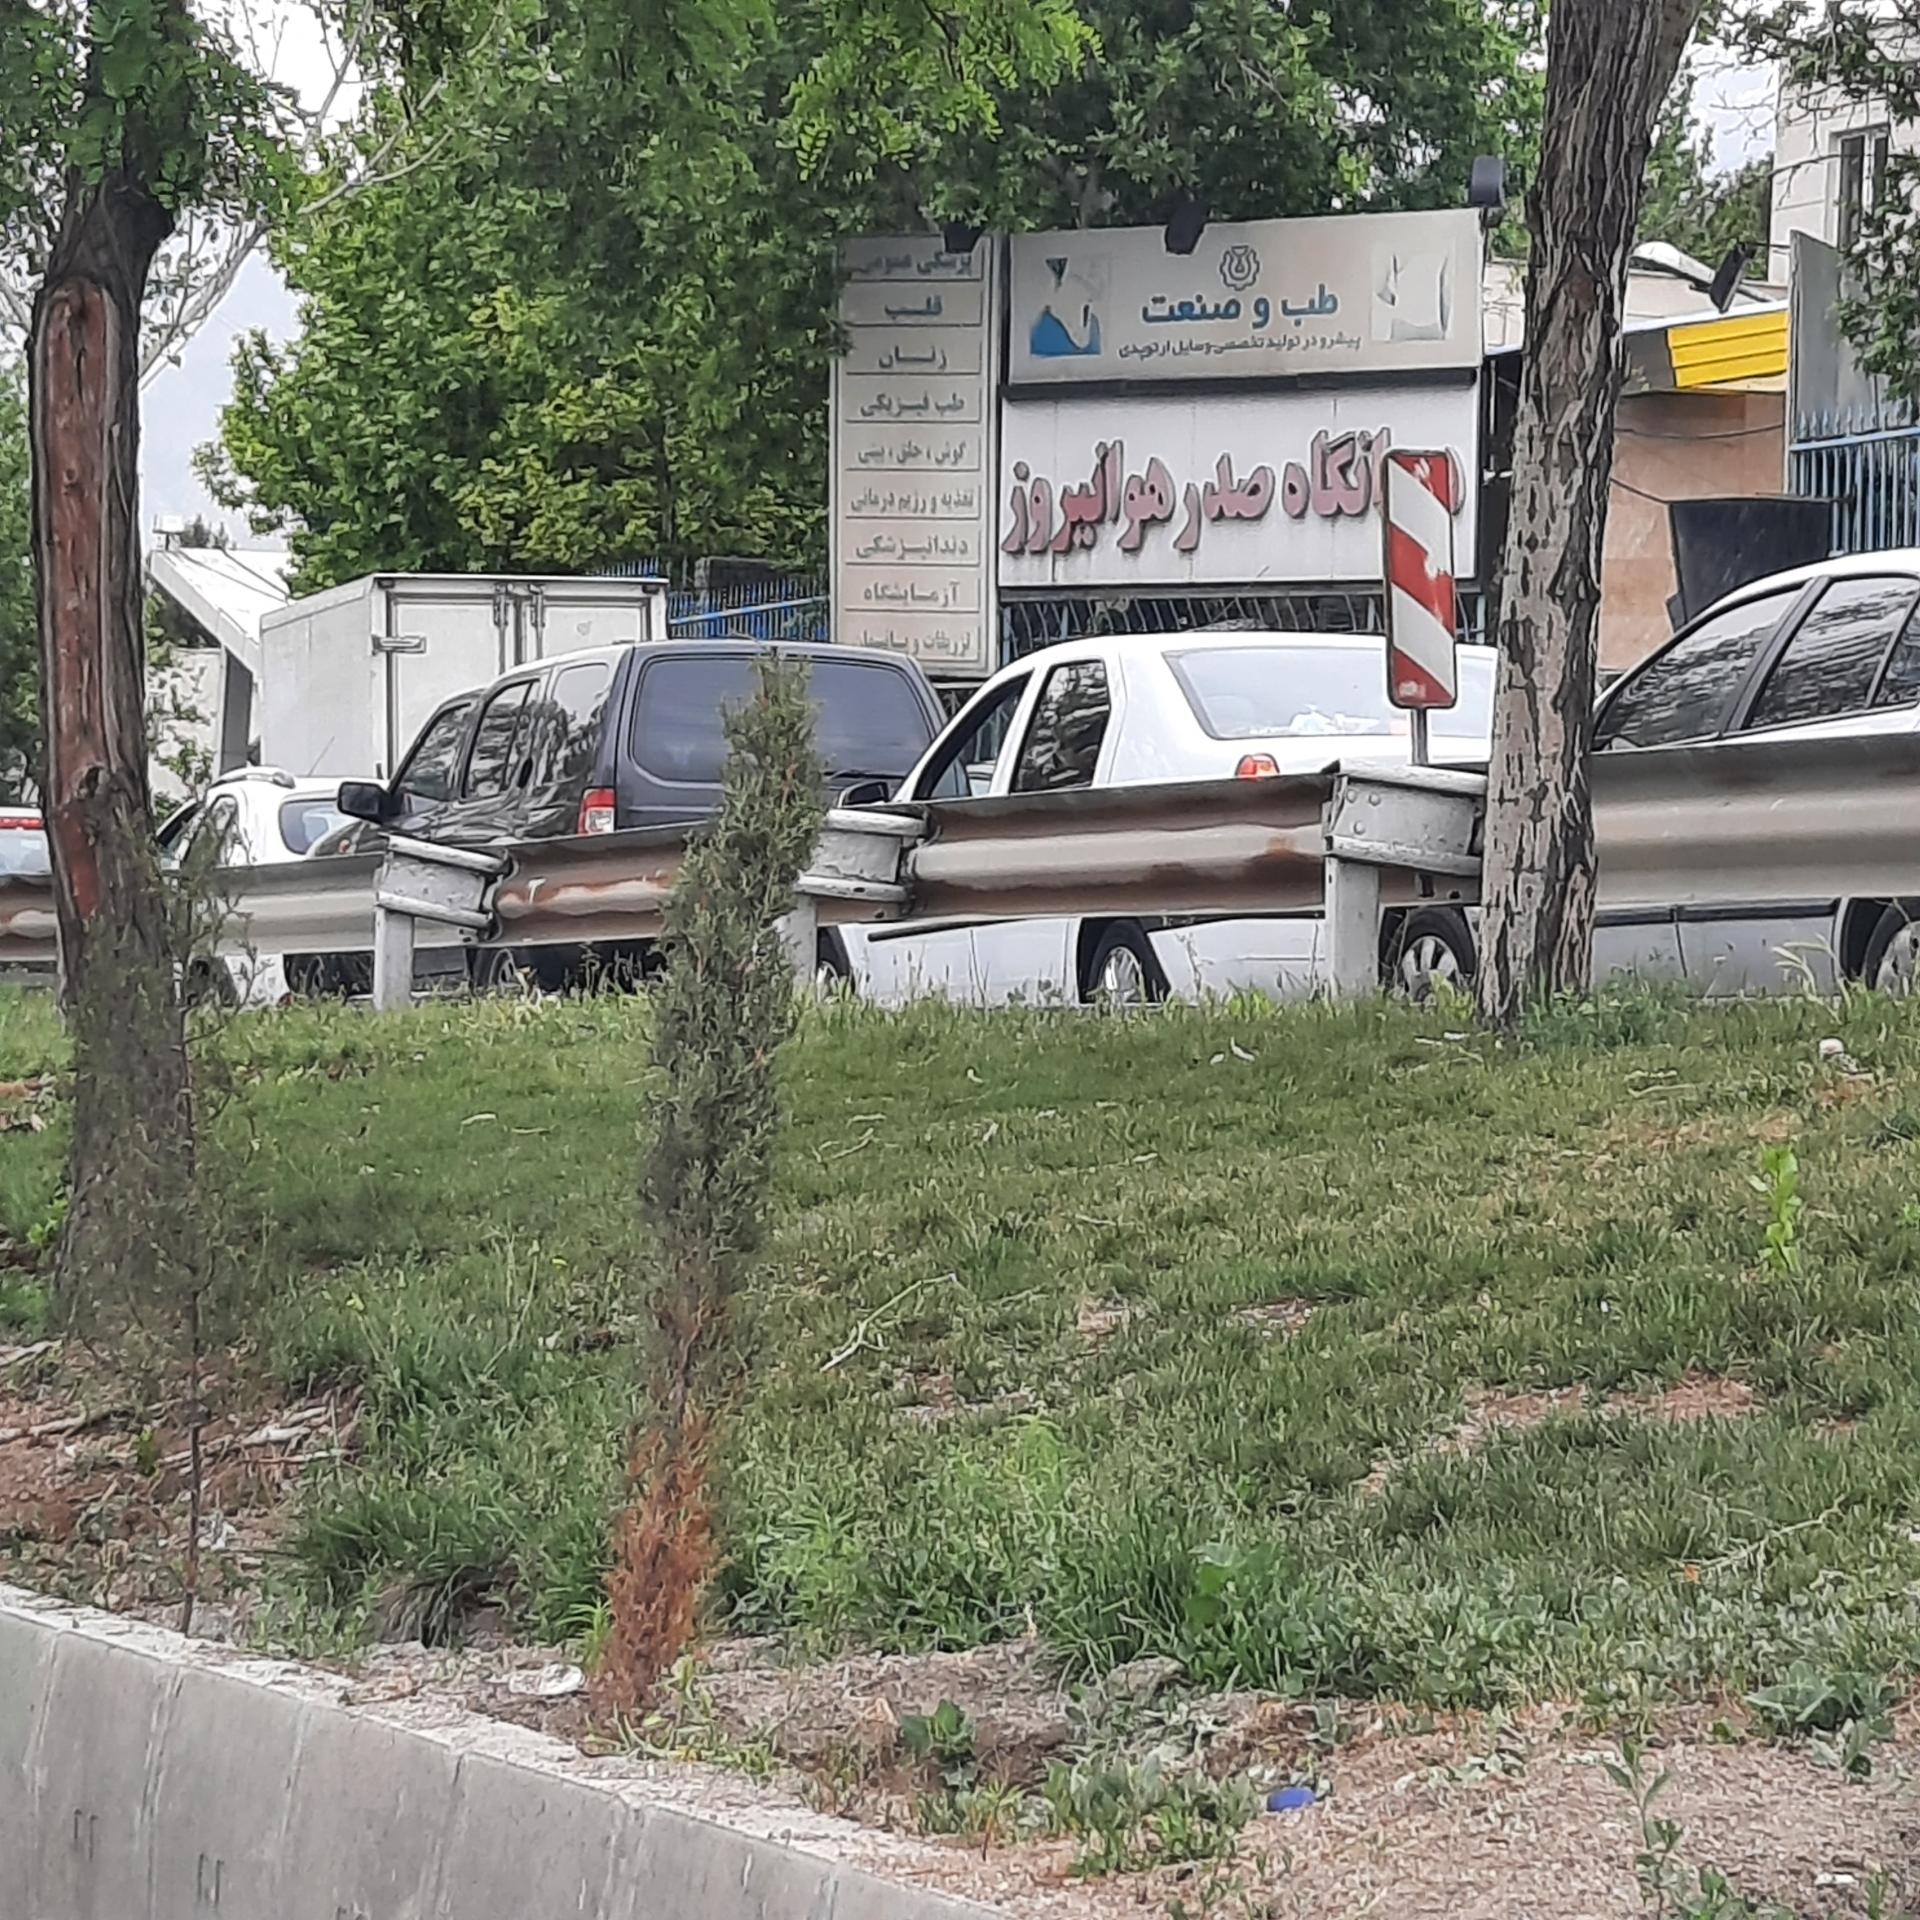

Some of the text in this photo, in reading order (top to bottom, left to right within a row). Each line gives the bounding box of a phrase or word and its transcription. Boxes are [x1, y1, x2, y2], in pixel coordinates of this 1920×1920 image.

[884, 294, 943, 320] قلب
[1142, 283, 1339, 330] طب و صنعت
[1118, 340, 1170, 361] ارتوپدی
[1172, 339, 1211, 356] وسایل
[1266, 334, 1301, 352] تولید
[1302, 335, 1318, 351] در
[878, 345, 947, 369] زنان
[860, 390, 965, 417] طب فیزیکی
[850, 487, 895, 513] درمانی
[1000, 439, 1177, 554] هوانیروز
[1173, 452, 1276, 553] صدر
[864, 580, 960, 607] آزمایشگاه
